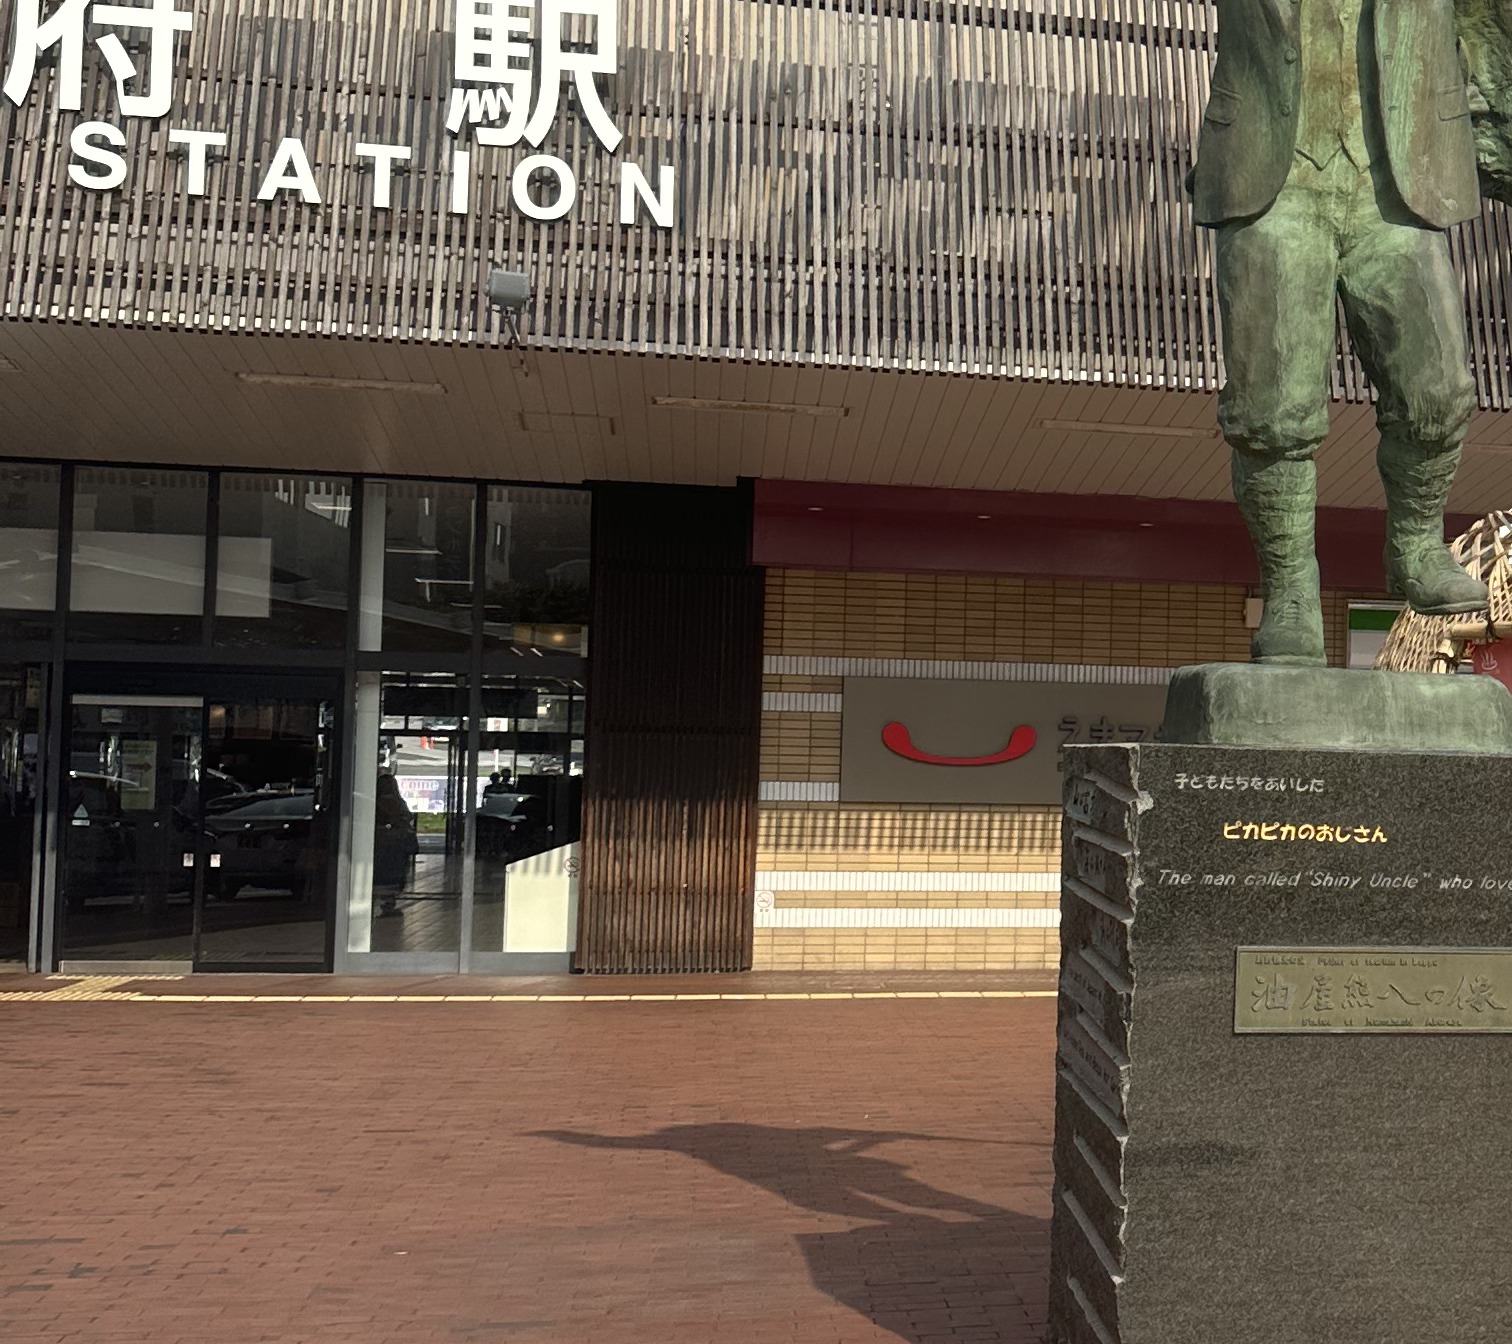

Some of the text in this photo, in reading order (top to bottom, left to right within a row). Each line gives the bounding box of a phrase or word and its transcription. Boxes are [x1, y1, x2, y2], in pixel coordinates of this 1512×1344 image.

[68, 121, 676, 229] STATION
[1174, 773, 1325, 793] 子どもたちをあいした
[1223, 821, 1388, 843] ピカピカのおじさん
[1158, 869, 1192, 885] The
[1200, 874, 1236, 886] man
[1244, 872, 1300, 886] called
[1440, 874, 1473, 890] who
